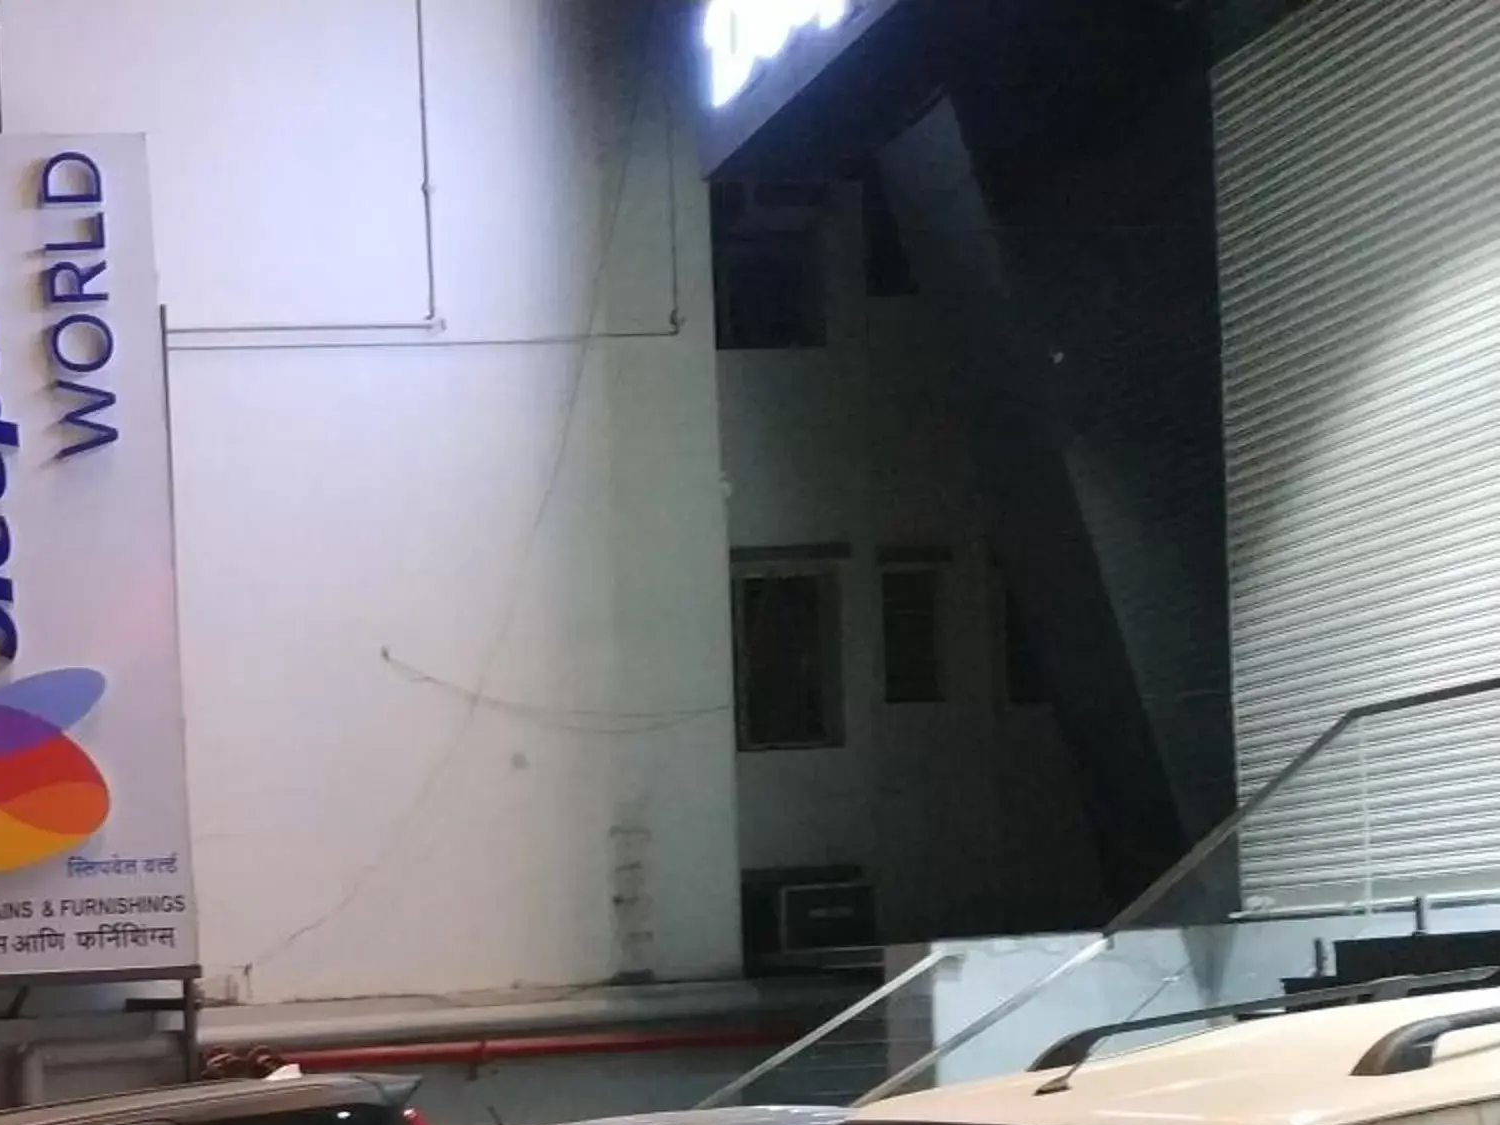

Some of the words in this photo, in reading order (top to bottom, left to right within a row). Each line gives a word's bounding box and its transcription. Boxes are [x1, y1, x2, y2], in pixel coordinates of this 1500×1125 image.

[43, 151, 119, 460] WORLD
[42, 900, 54, 917] &
[61, 895, 185, 916] FURNISHINGS
[11, 926, 66, 956] आणि
